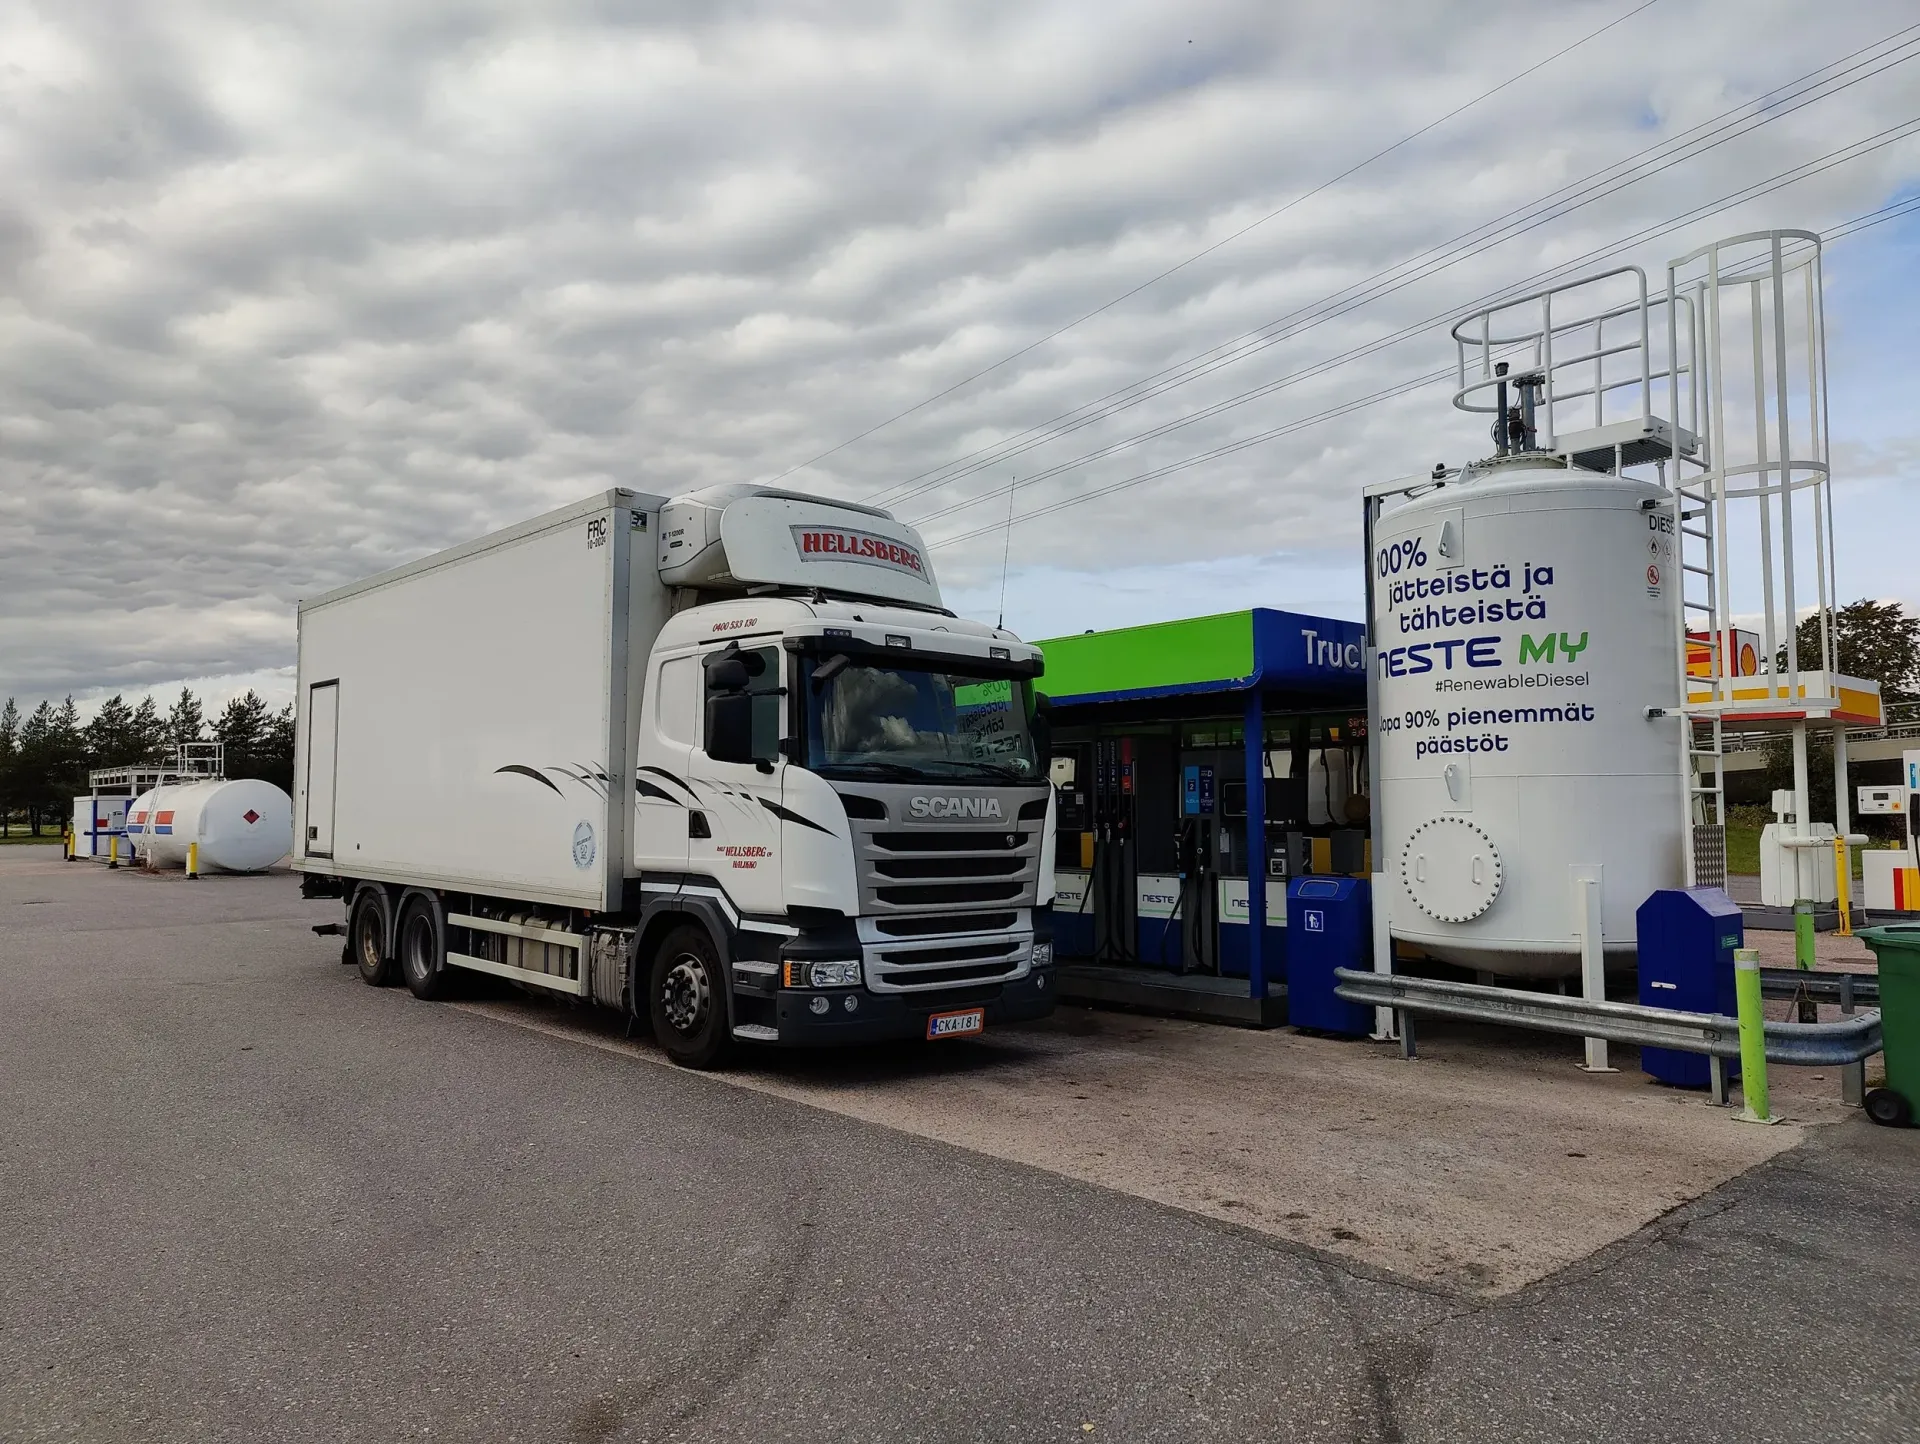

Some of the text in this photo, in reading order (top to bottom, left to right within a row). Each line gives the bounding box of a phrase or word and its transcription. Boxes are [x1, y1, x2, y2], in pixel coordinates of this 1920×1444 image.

[587, 517, 607, 540] FRC
[1648, 514, 1674, 536] DIESE
[802, 532, 922, 574] HELLSBERG
[1376, 536, 1427, 580] 100%
[1388, 562, 1554, 613] jätteistä ja
[729, 620, 744, 630] 533
[744, 617, 758, 628] 130
[1400, 594, 1547, 633] tähteistä
[1378, 632, 1589, 681] NESTE MY
[1435, 671, 1590, 693] #RenewableDiesel
[1404, 709, 1440, 729] 90%
[1447, 702, 1595, 731] pienemmät
[1416, 733, 1509, 760] päästöt
[908, 796, 1002, 818] SCANIA
[725, 846, 767, 857] HELLSBERG
[1142, 894, 1175, 904] NESTE
